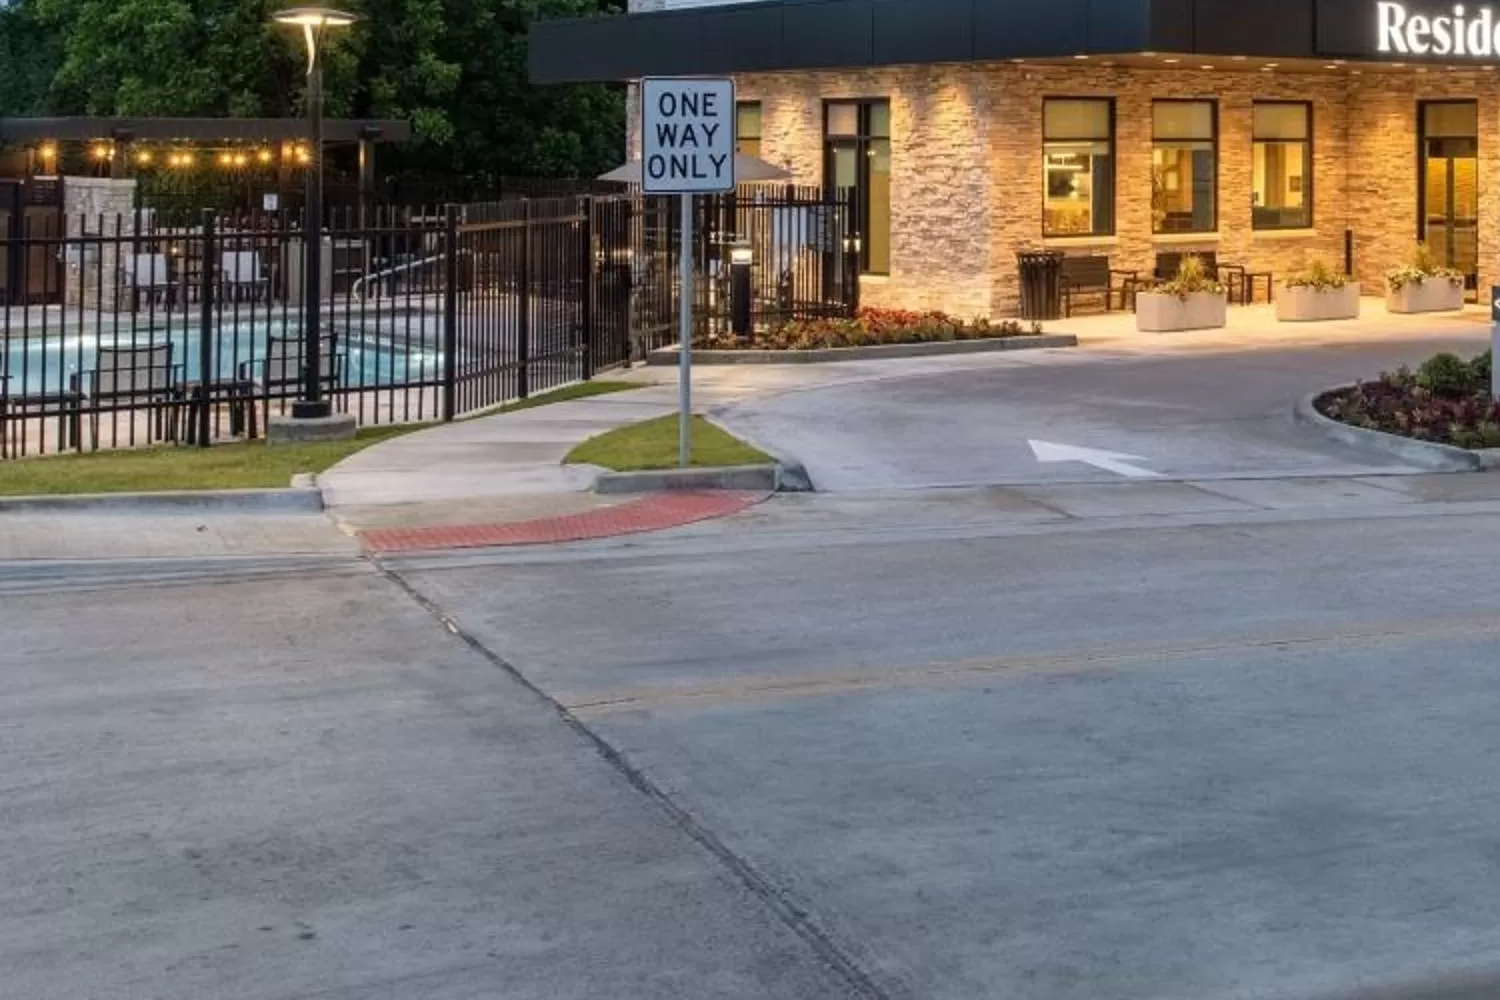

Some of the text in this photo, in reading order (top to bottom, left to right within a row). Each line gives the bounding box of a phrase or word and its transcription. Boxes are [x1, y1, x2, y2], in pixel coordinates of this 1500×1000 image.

[659, 92, 718, 117] ONE
[656, 123, 720, 148] WAY
[648, 153, 728, 179] ONLY
